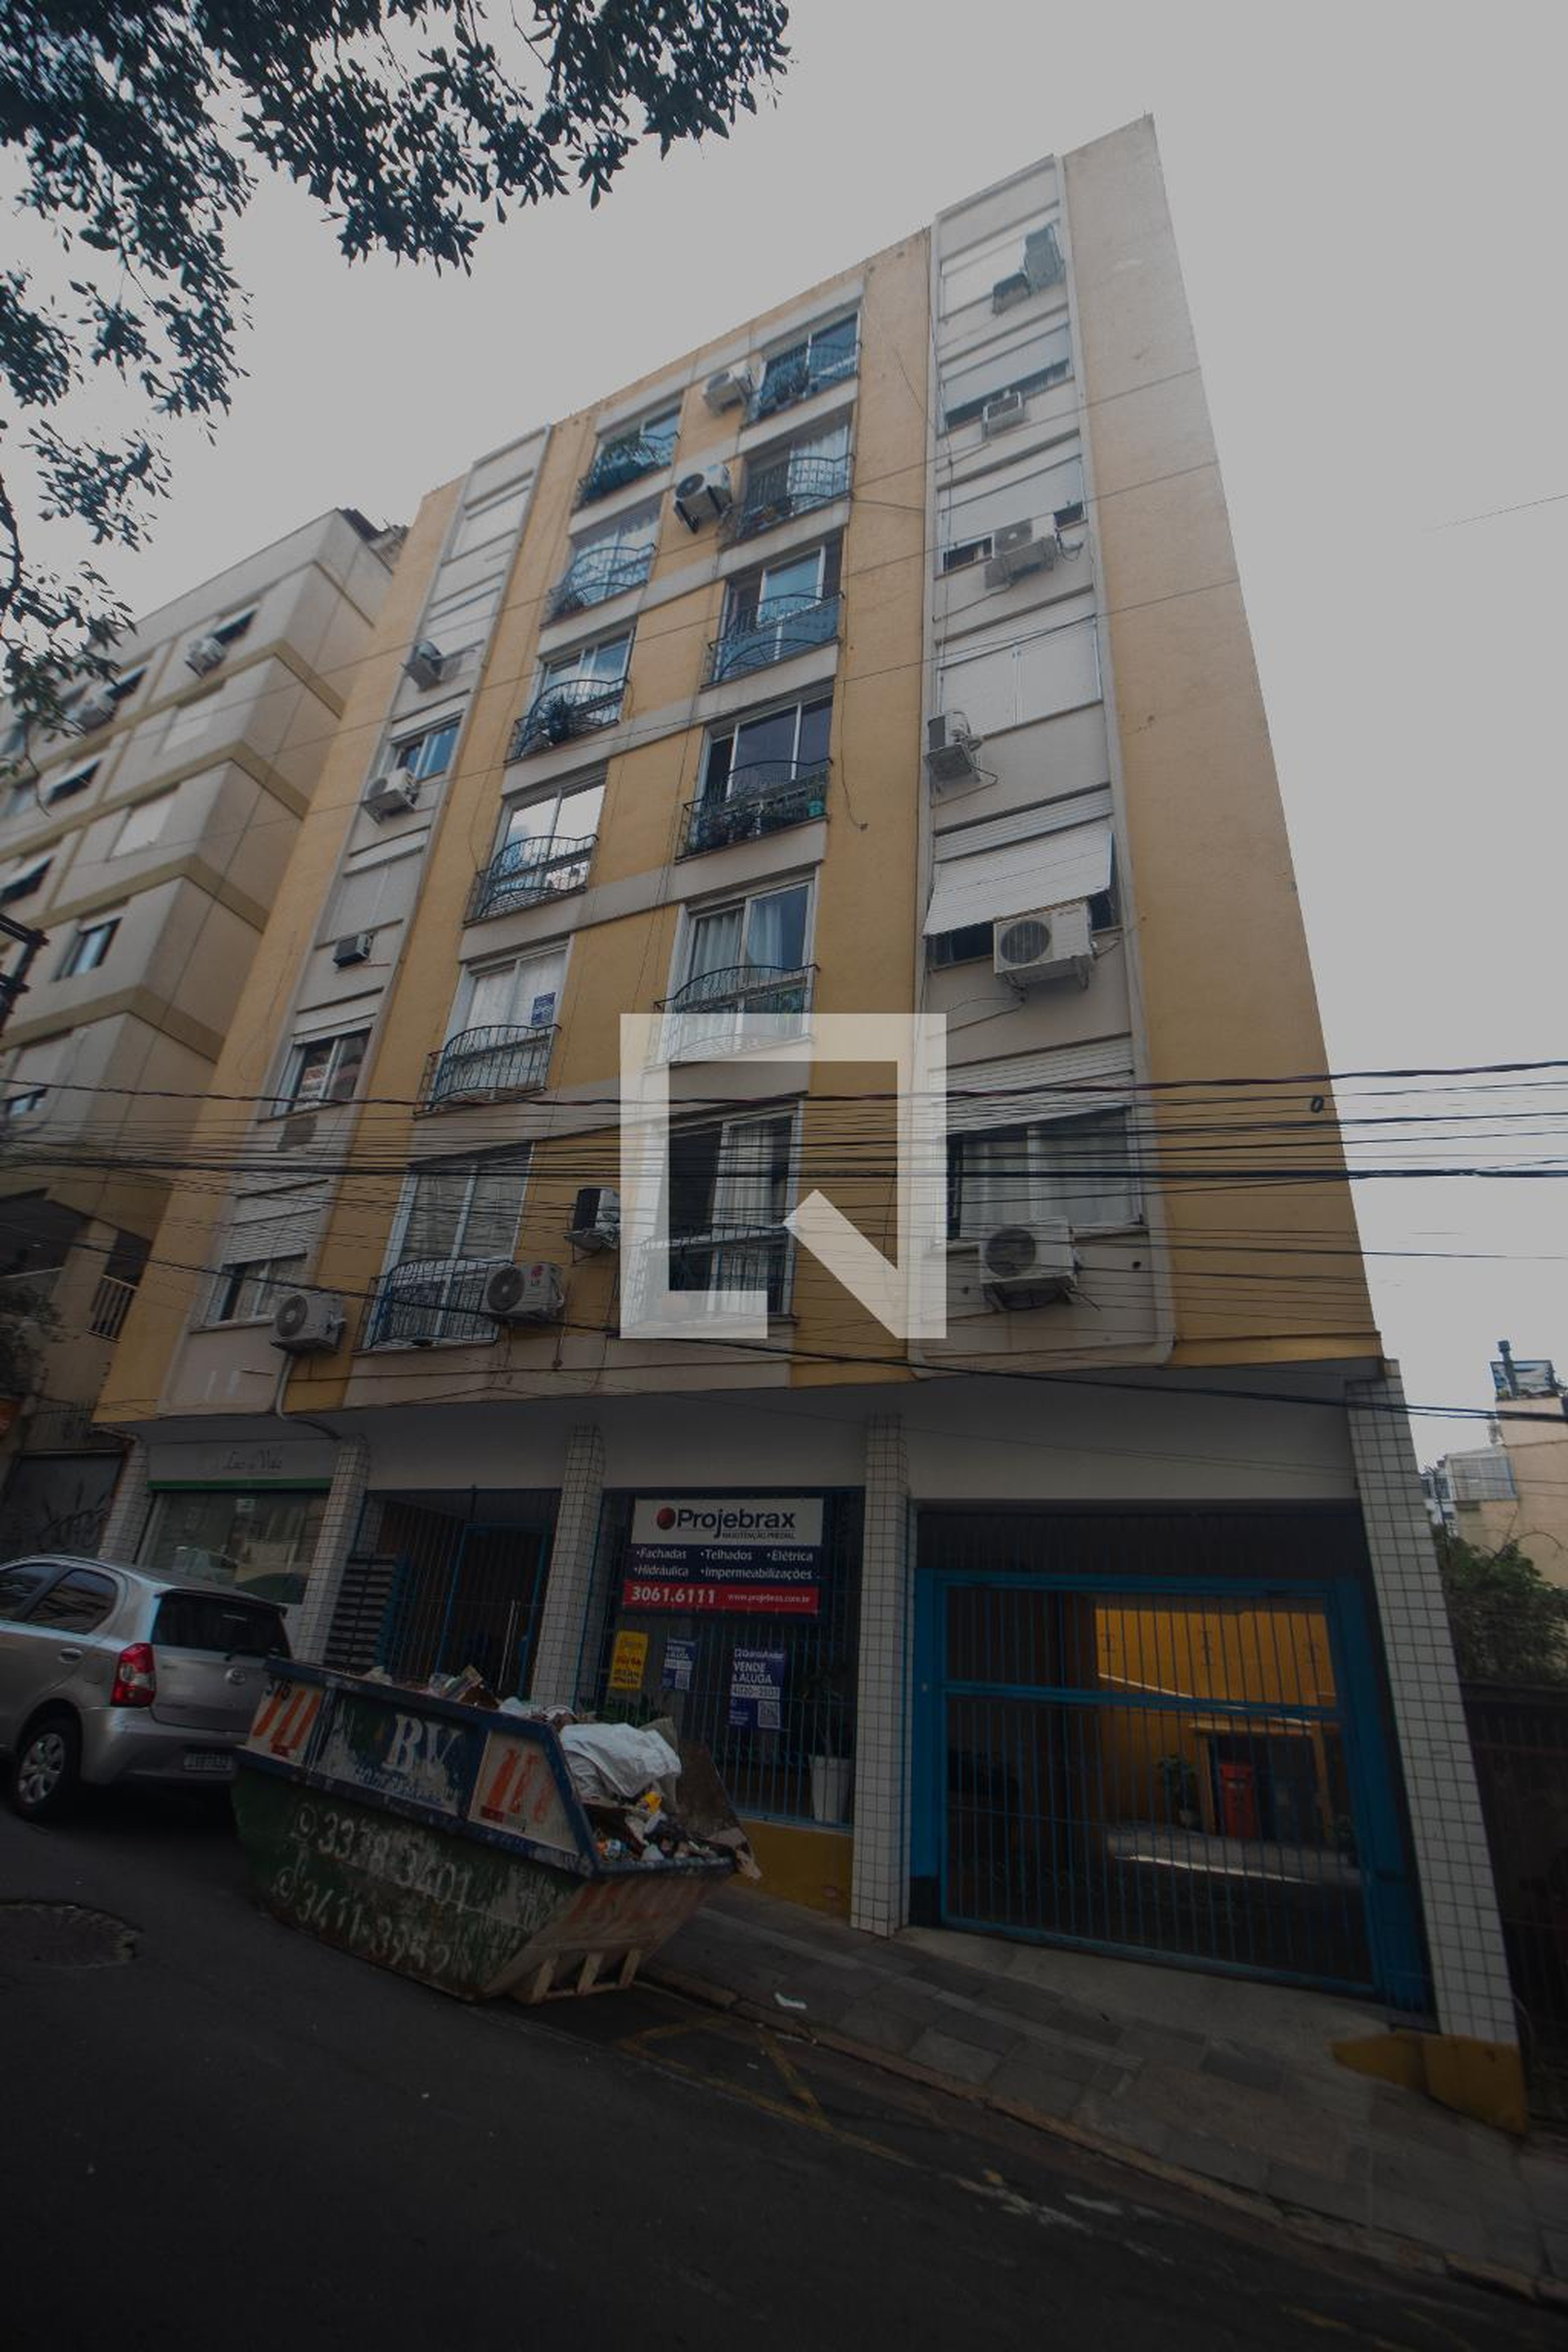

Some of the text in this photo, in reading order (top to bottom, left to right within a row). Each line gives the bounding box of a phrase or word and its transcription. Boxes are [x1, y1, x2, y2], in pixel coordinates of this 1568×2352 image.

[677, 1508, 796, 1538] Projebrax
[639, 1548, 687, 1559] Fachadas
[705, 1550, 752, 1561] Telhados
[632, 1586, 715, 1604] 3061.6111
[733, 1659, 766, 1673] VENDE
[738, 1673, 772, 1684] ALUGA
